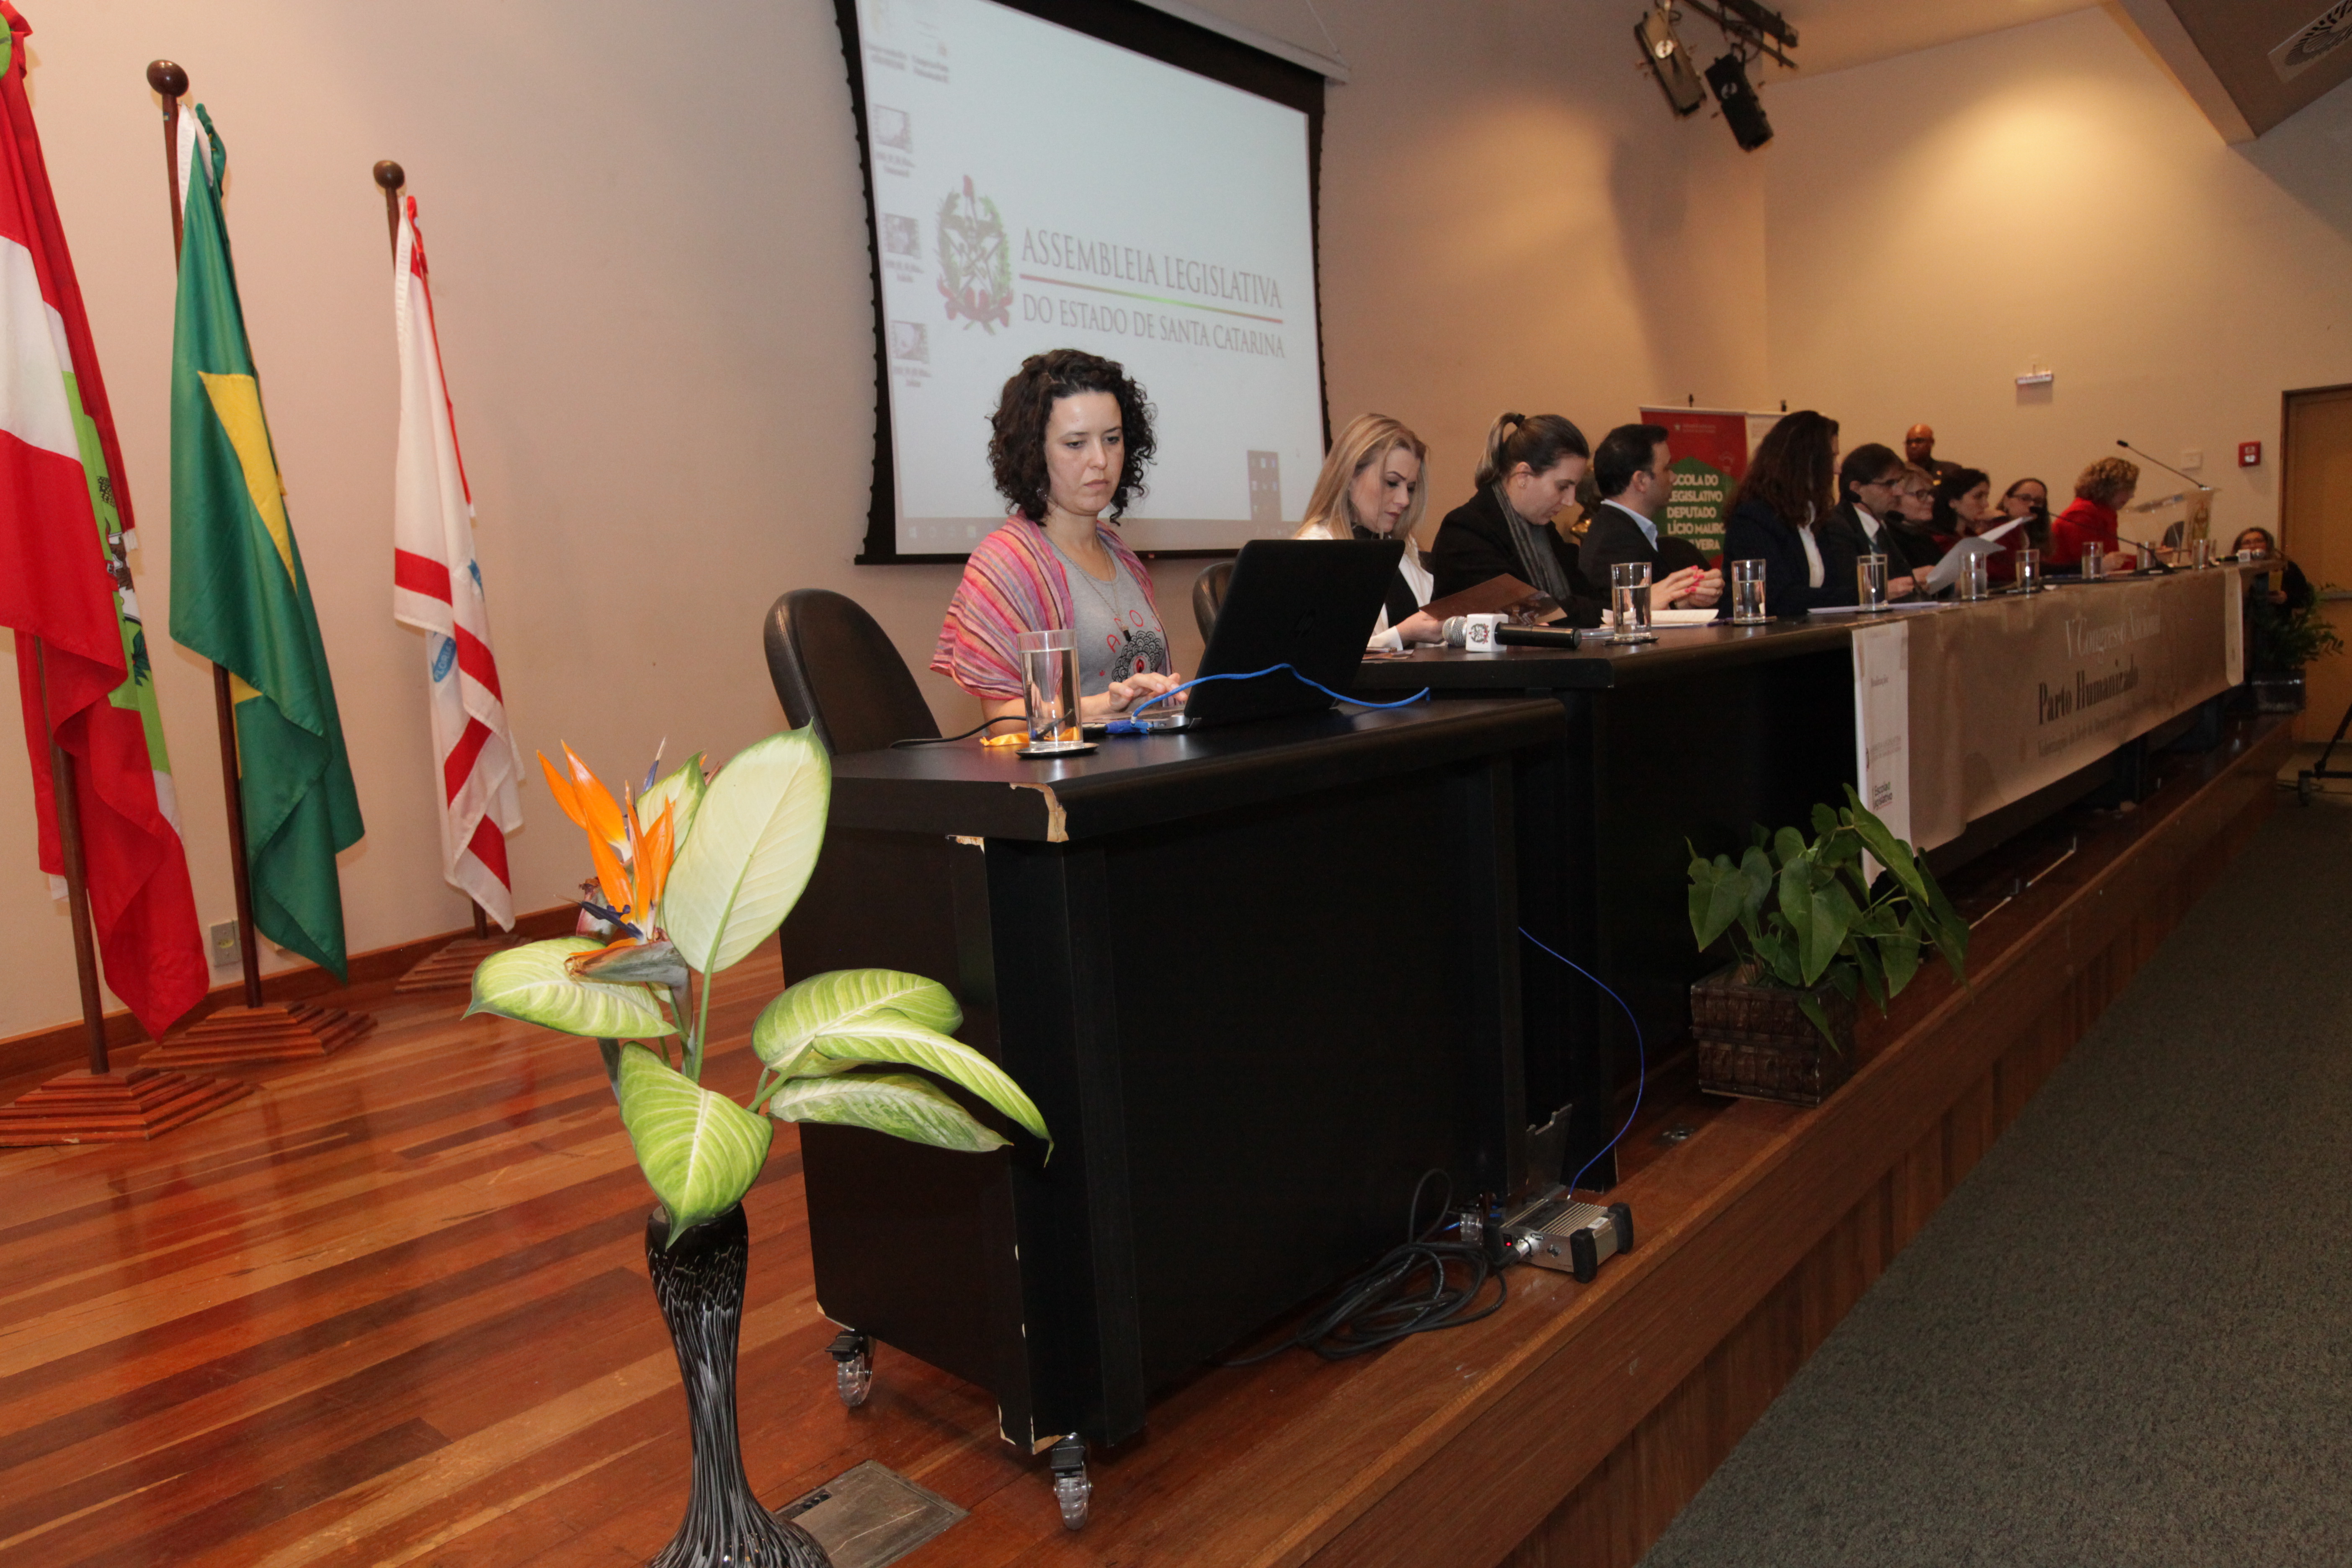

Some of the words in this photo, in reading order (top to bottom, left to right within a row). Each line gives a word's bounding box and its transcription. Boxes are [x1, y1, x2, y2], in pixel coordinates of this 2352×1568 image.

[1021, 227, 1159, 285] ASSEMBLEIA
[1164, 255, 1282, 309] LEGISLATIVA
[1022, 293, 1053, 324] DO
[1059, 299, 1127, 334] ESTADO
[1132, 310, 1155, 339] DE
[1159, 315, 1210, 347] SANTA
[1213, 325, 1285, 358] CATARINA
[1666, 506, 1717, 518] DEPUTADO
[1704, 474, 1719, 486] DO
[2039, 681, 2073, 725] Parto
[2076, 654, 2139, 711] Humanizado
